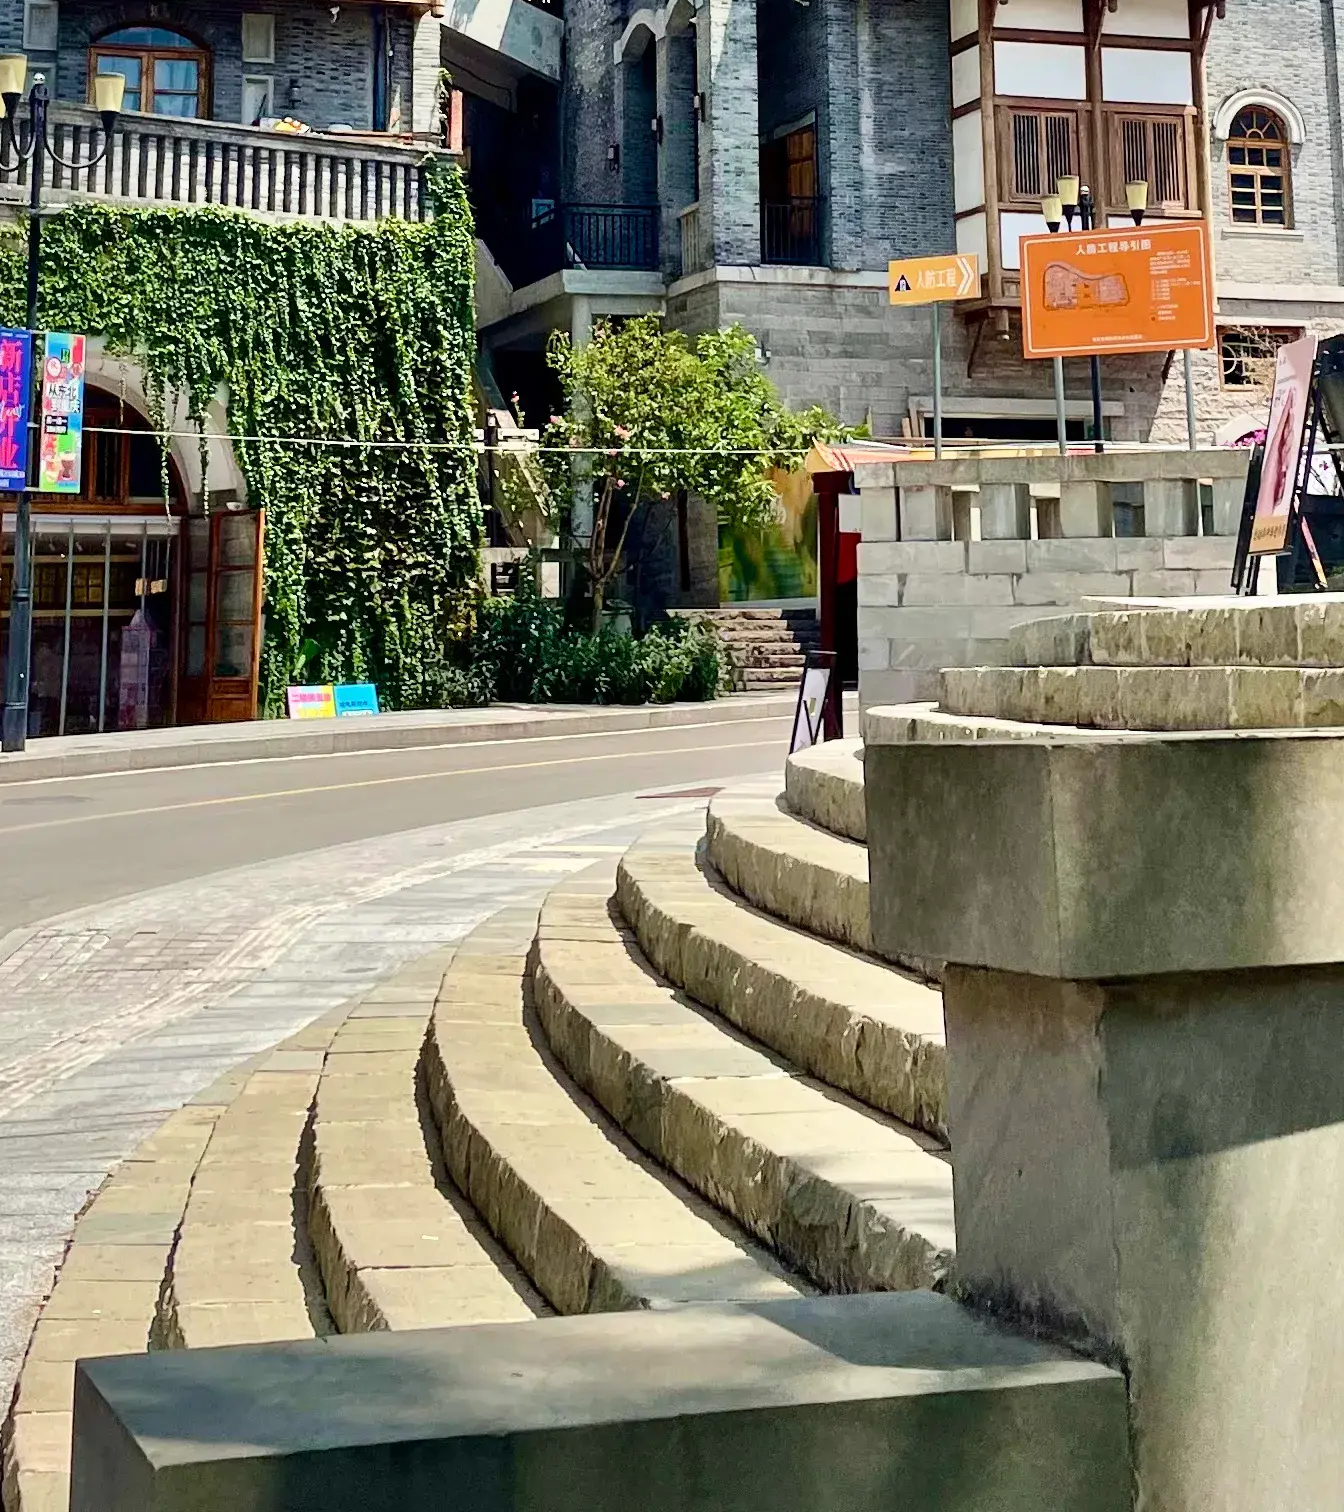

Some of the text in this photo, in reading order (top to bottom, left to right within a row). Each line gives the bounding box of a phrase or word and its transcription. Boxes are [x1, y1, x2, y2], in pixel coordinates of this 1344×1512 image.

[1075, 239, 1152, 256] 人防工程导引图
[917, 268, 957, 289] 人防工程
